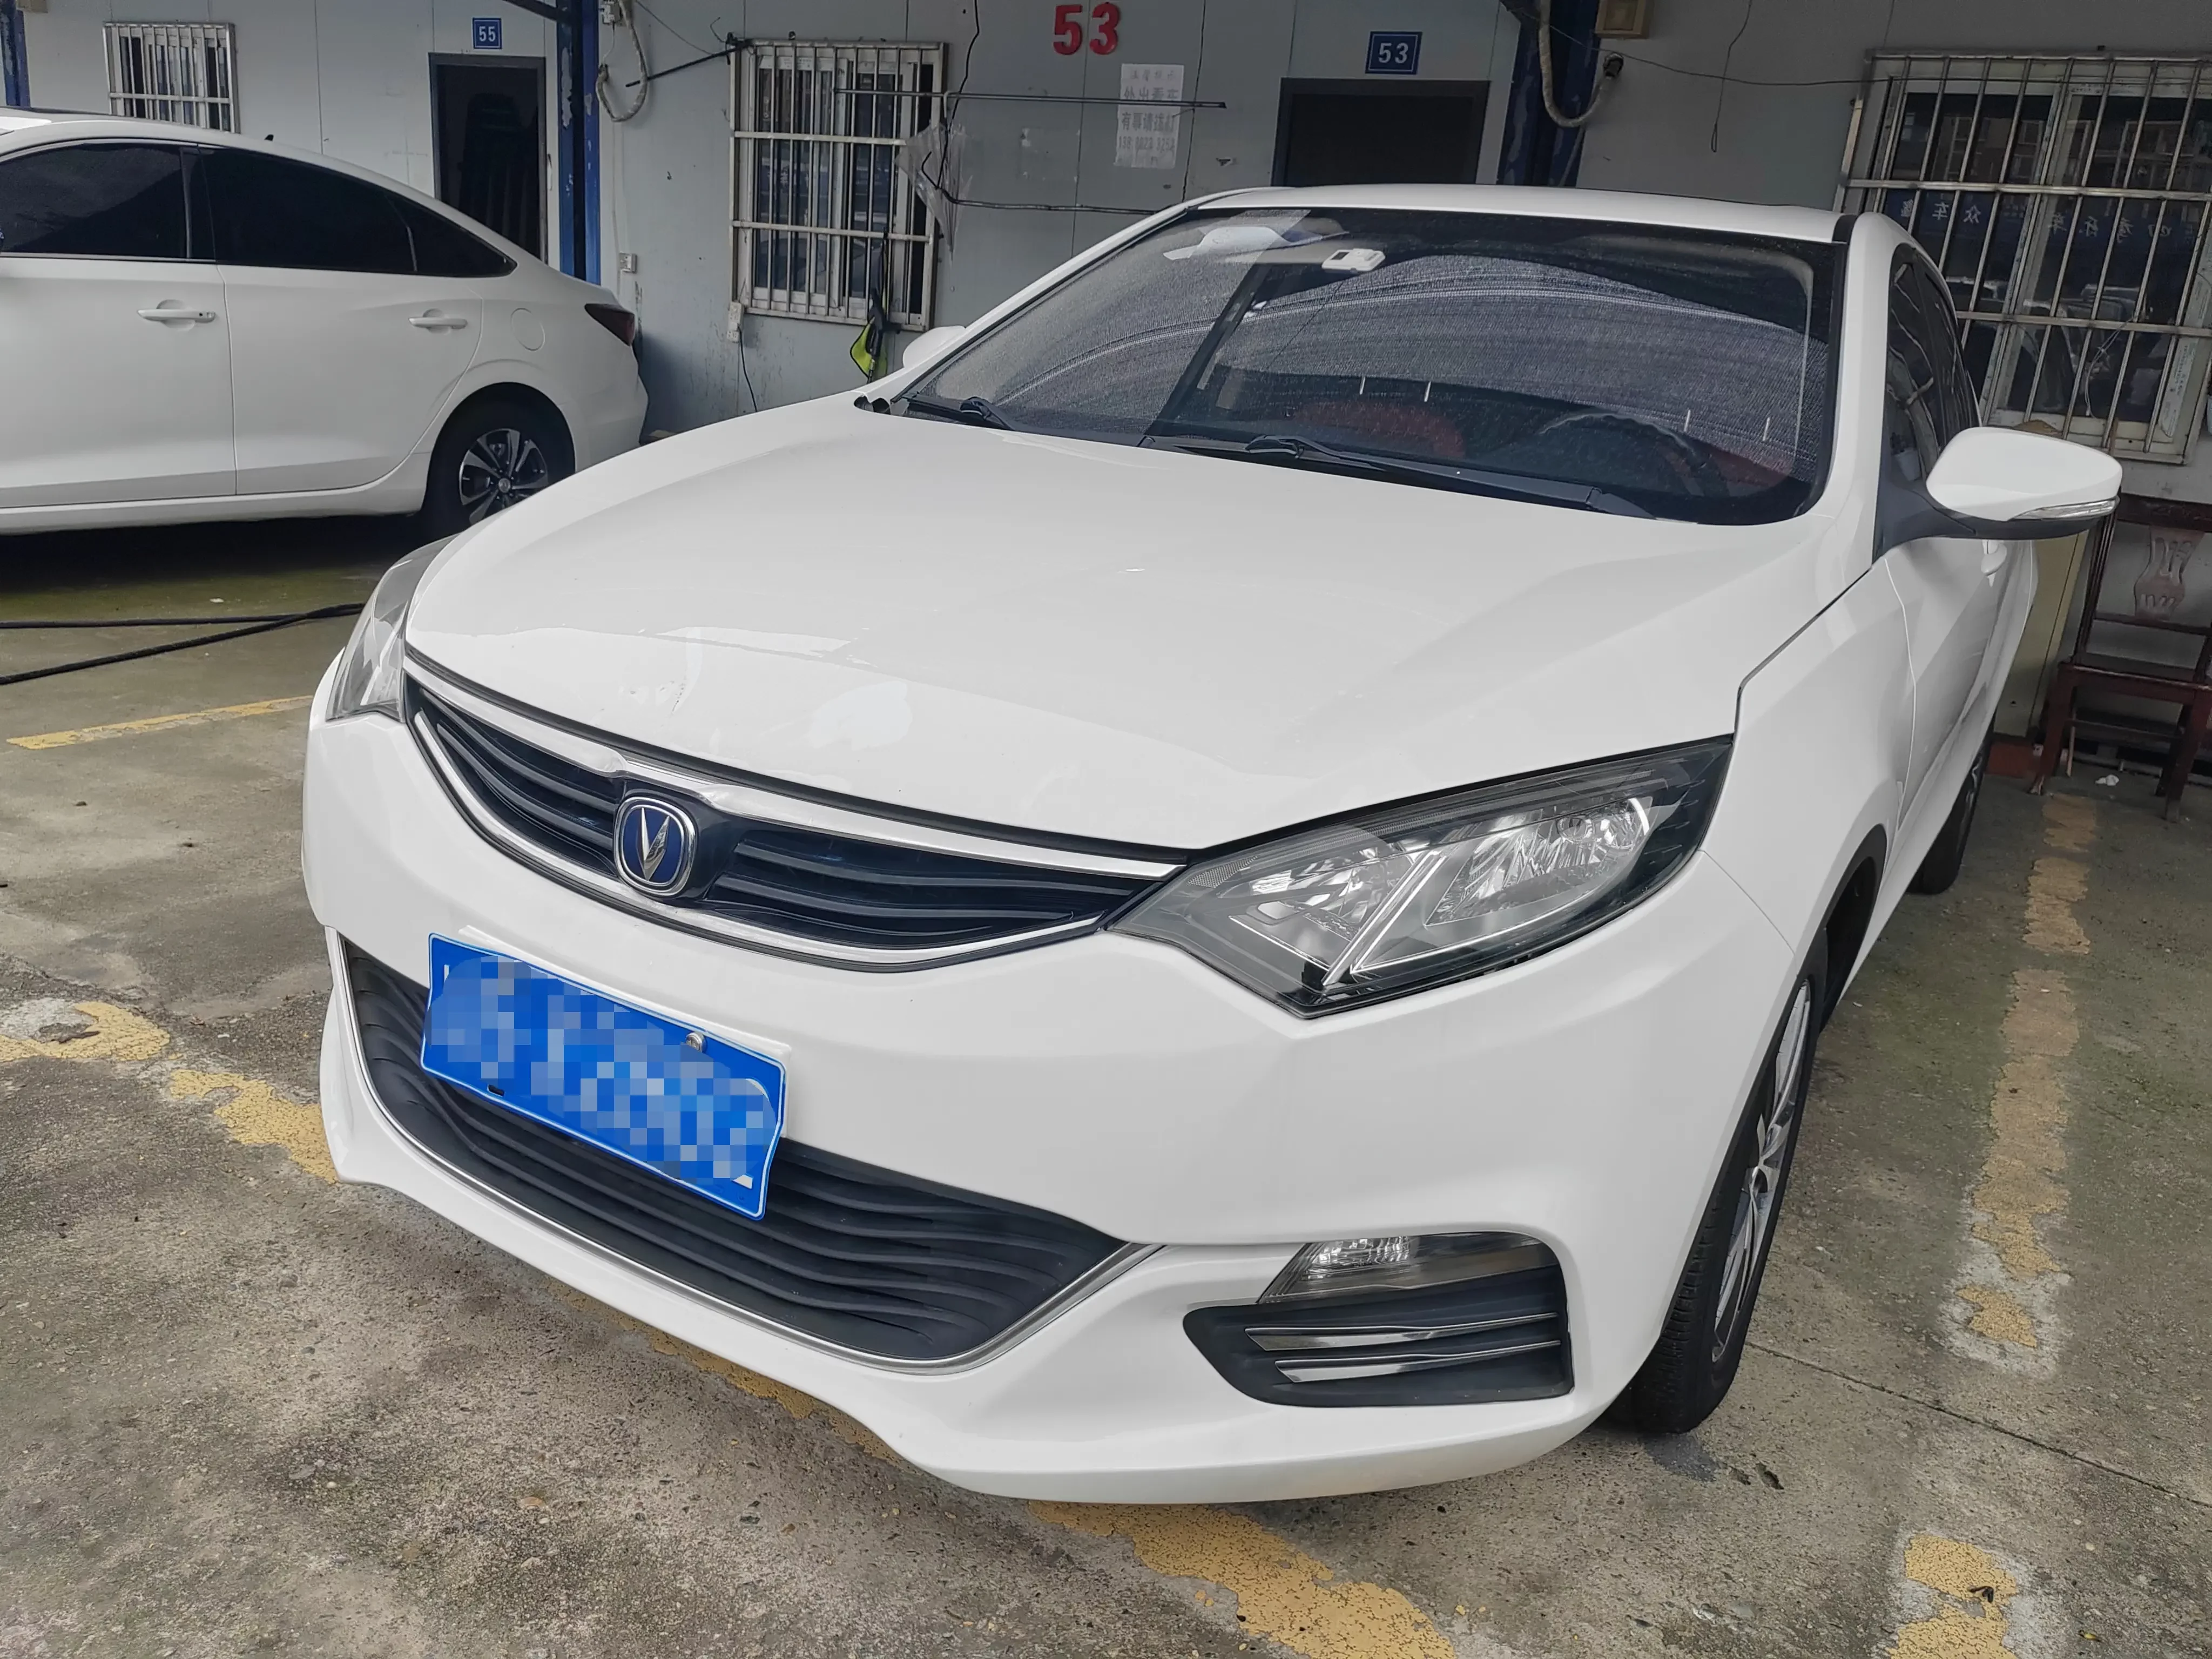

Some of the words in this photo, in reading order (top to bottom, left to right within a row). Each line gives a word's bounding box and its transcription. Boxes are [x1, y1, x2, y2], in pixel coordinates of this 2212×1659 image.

[478, 25, 496, 42] 55
[1053, 3, 1120, 56] 53
[1378, 42, 1409, 64] 53
